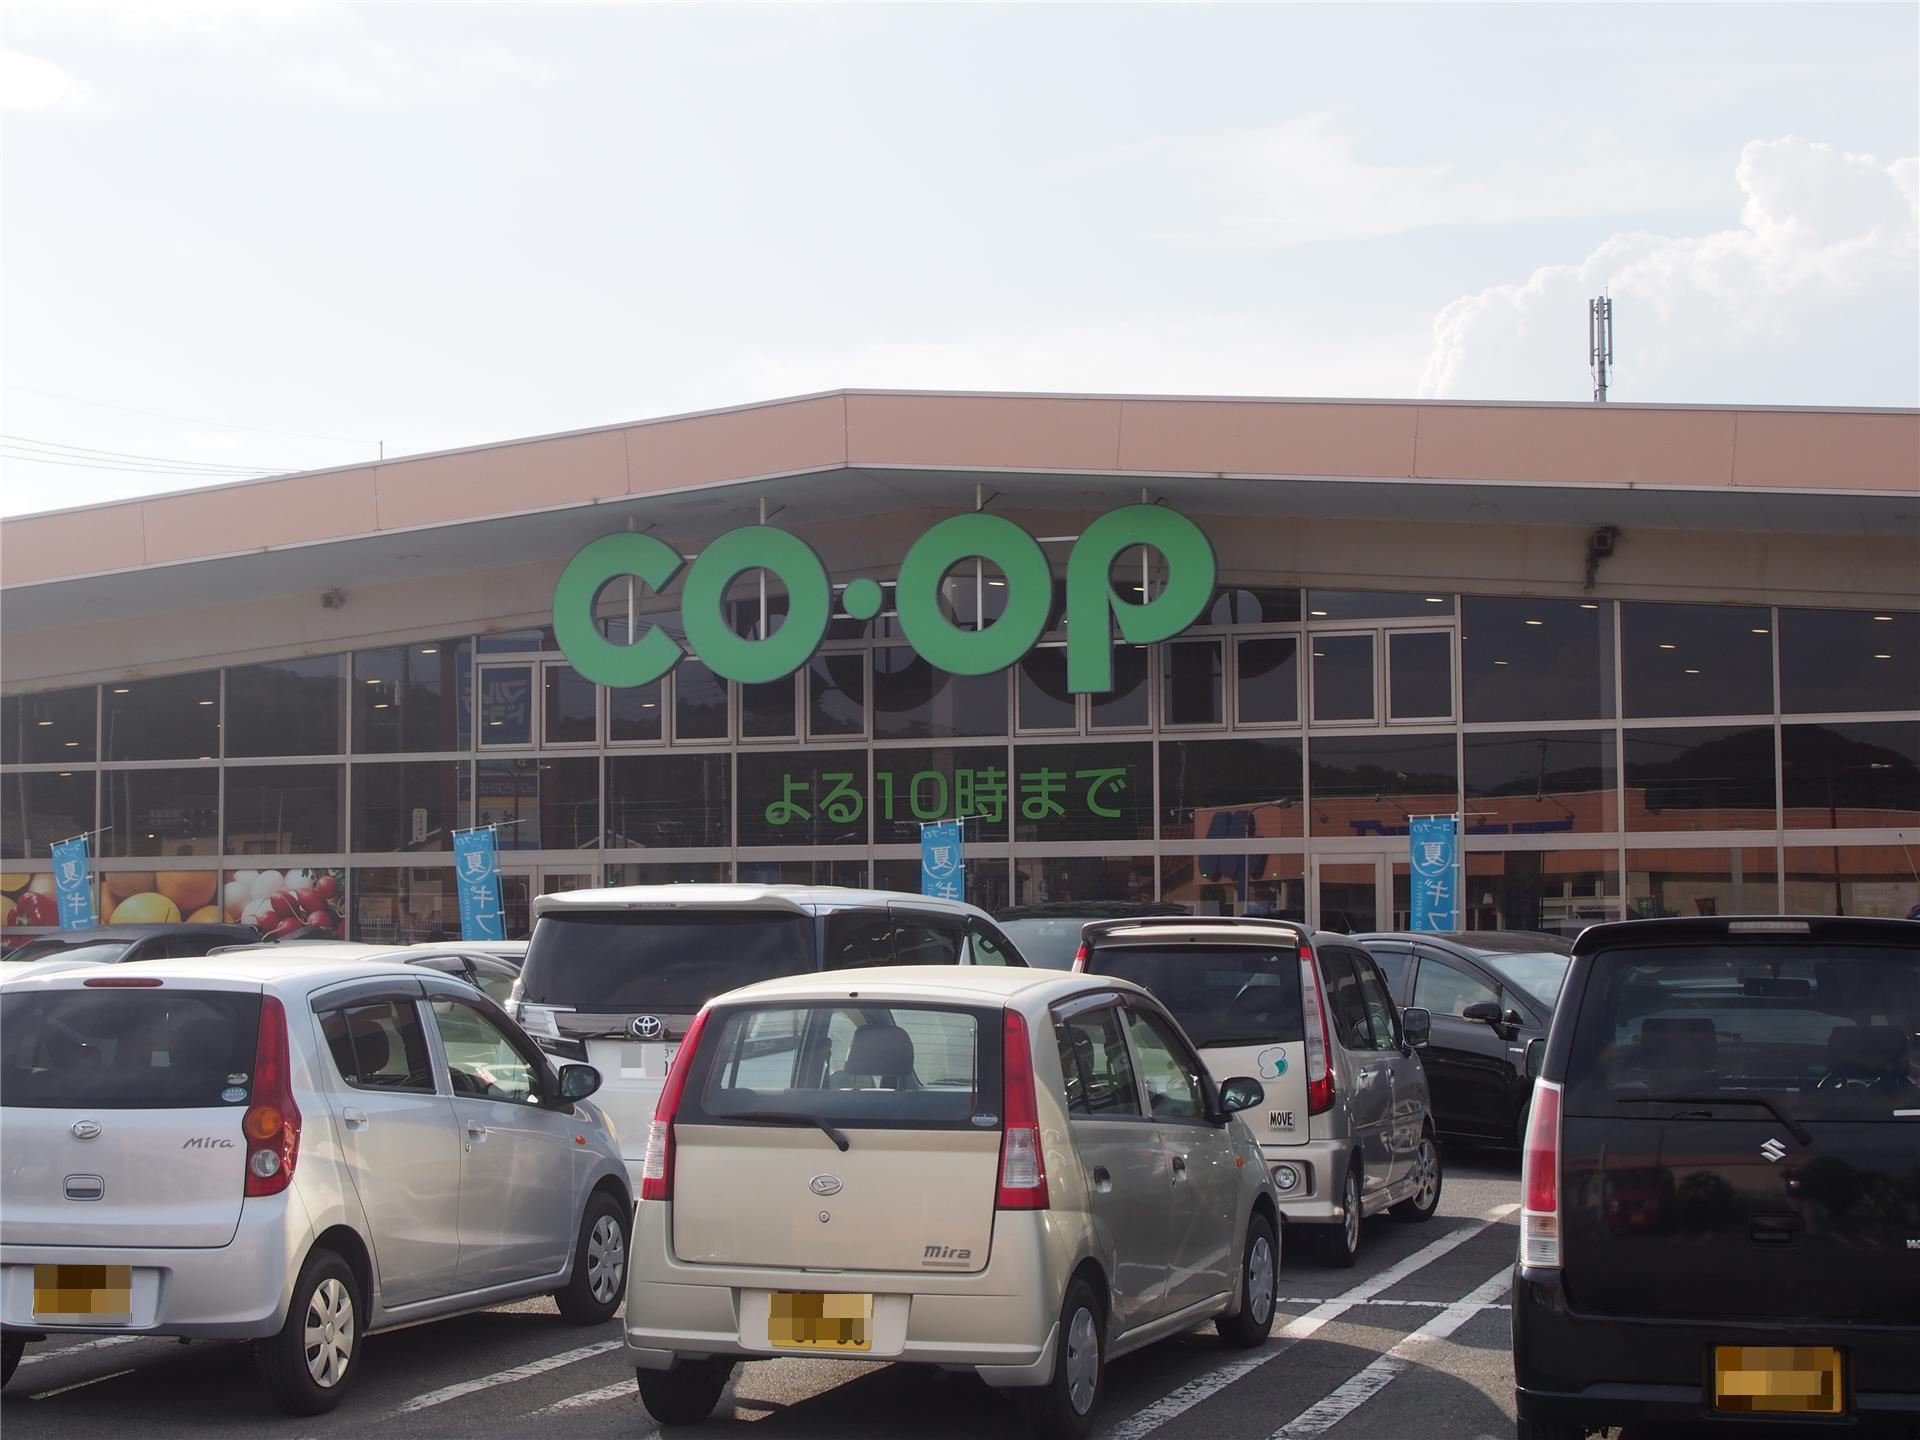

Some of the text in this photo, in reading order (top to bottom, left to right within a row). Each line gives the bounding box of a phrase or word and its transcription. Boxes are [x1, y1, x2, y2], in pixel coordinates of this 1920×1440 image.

[764, 765, 1127, 826] よる10時まで
[1270, 1111, 1294, 1126] MOVE
[183, 1136, 235, 1149] Mira
[923, 1245, 972, 1259] Mira
